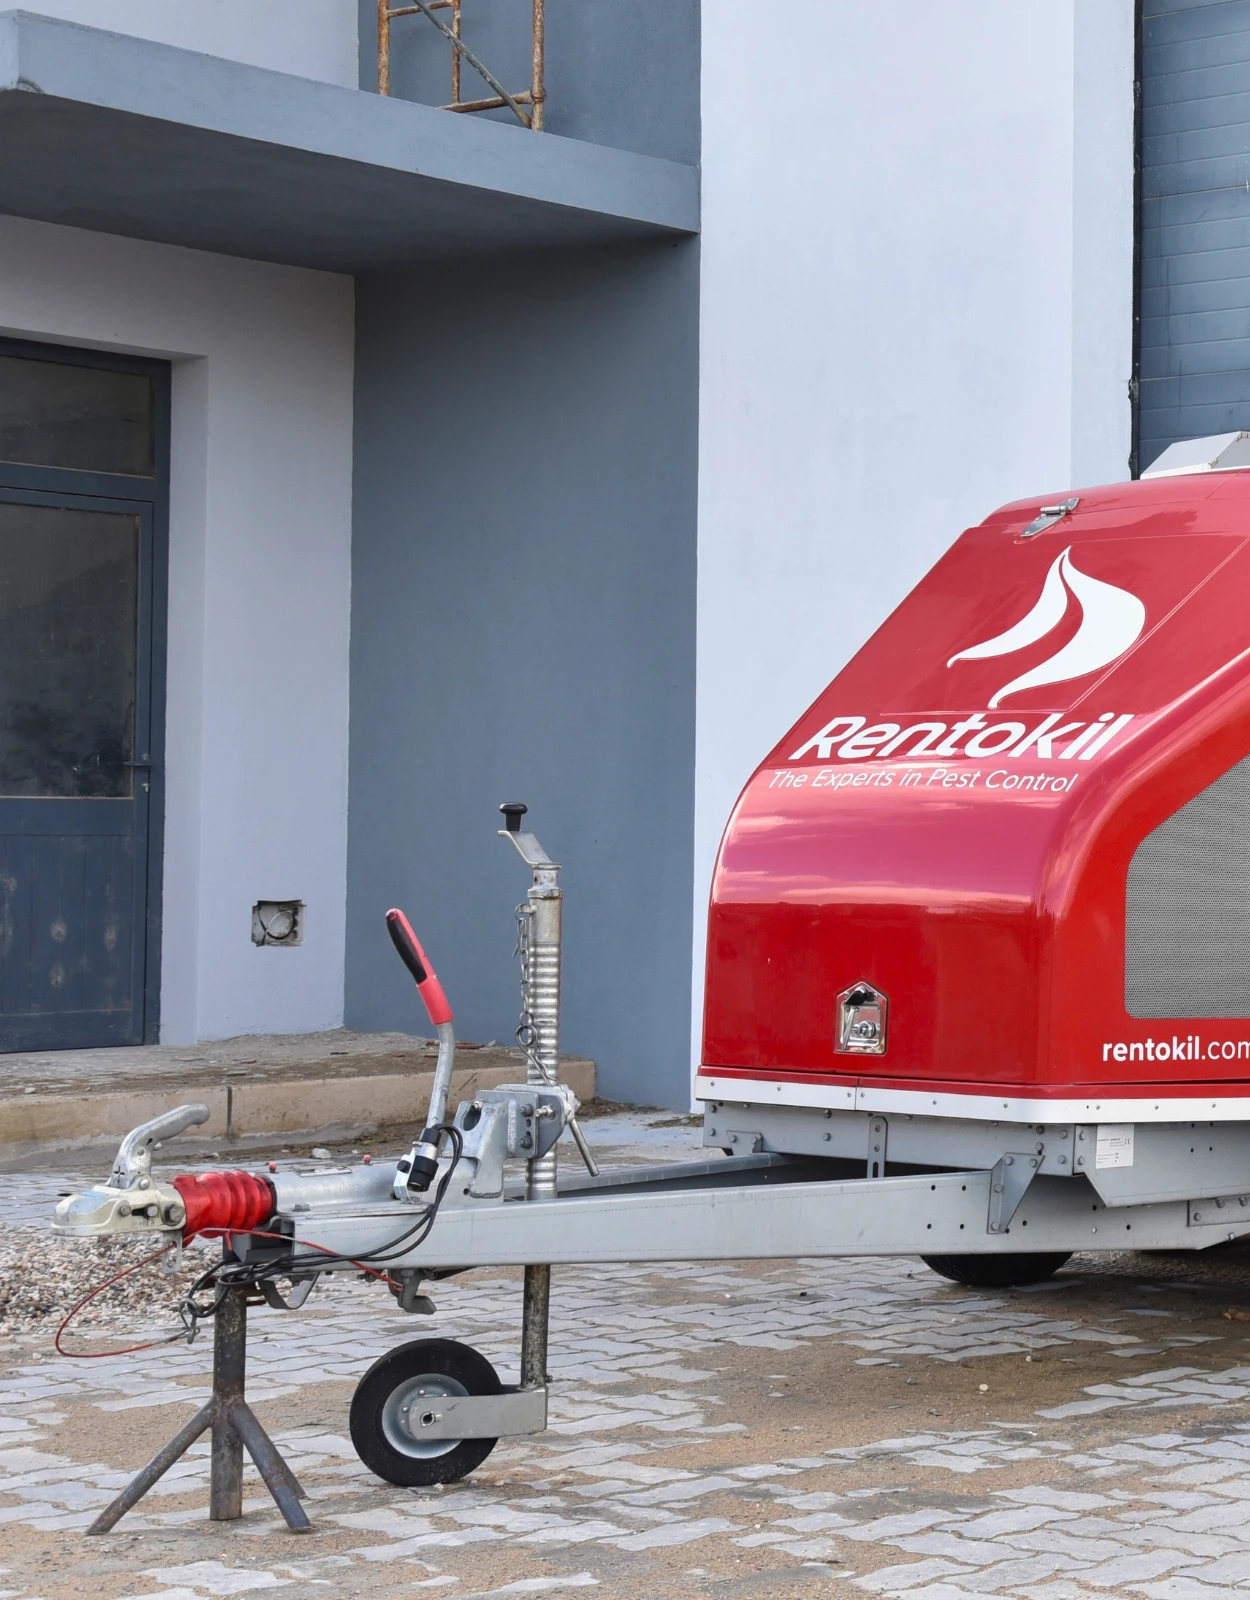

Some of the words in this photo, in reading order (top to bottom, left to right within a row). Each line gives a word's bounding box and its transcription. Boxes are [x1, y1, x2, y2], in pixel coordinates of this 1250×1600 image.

[787, 712, 1135, 761] Rentokil
[768, 770, 808, 788] The
[811, 769, 897, 791] Experts
[899, 768, 922, 786] in
[925, 768, 981, 788] Pest
[985, 770, 1079, 793] Control
